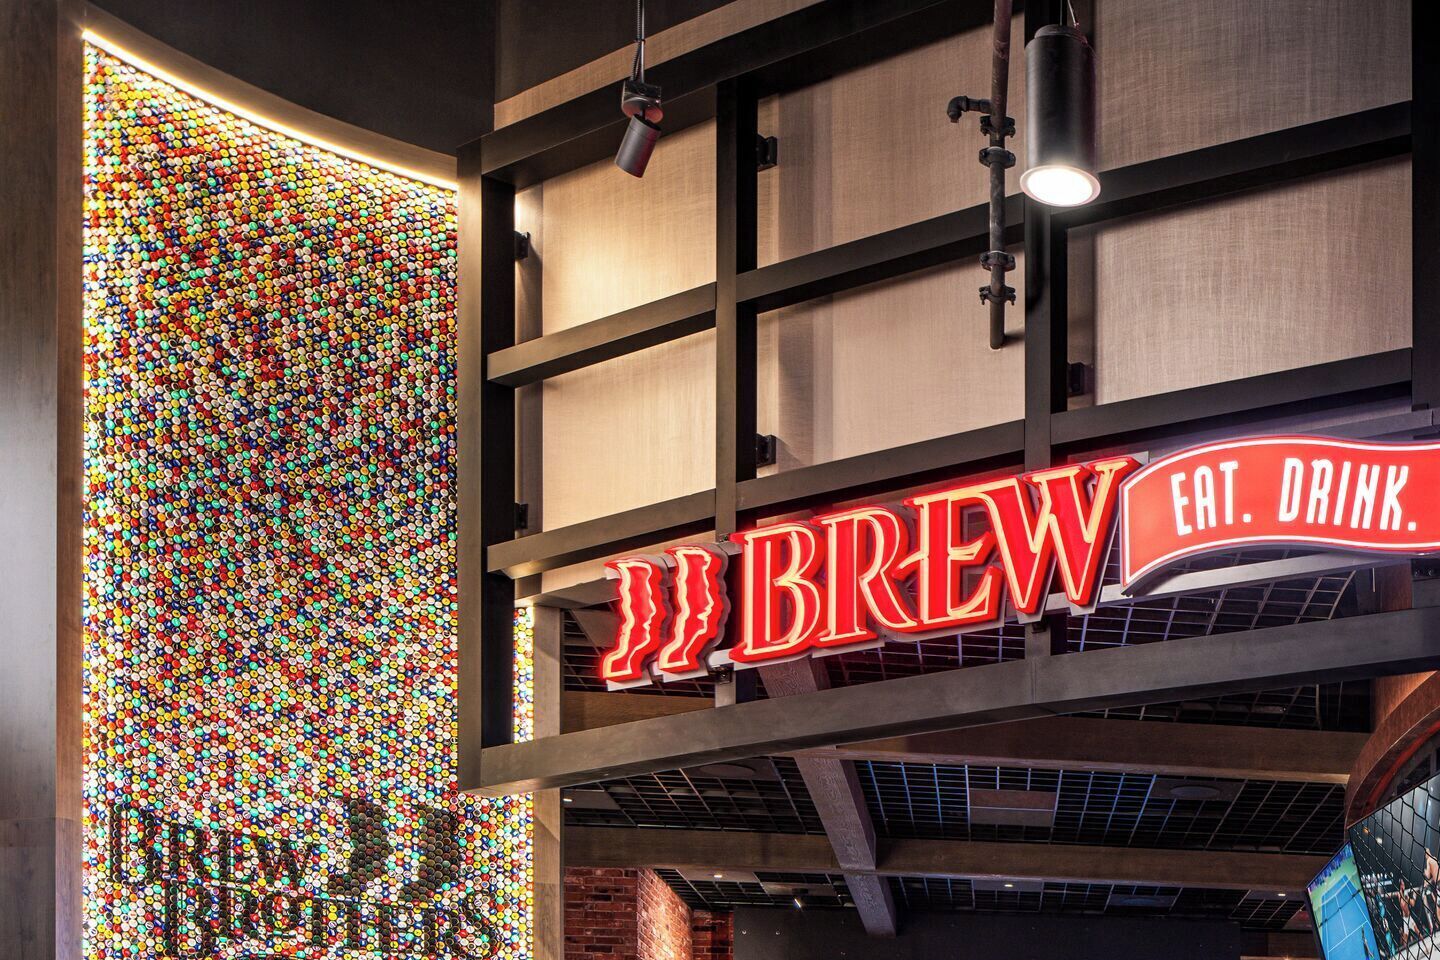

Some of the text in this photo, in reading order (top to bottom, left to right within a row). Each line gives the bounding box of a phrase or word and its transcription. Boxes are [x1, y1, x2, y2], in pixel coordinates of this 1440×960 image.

[729, 456, 1140, 662] BREW
[1170, 460, 1252, 536] EAT.
[1278, 457, 1417, 532] DRINK.
